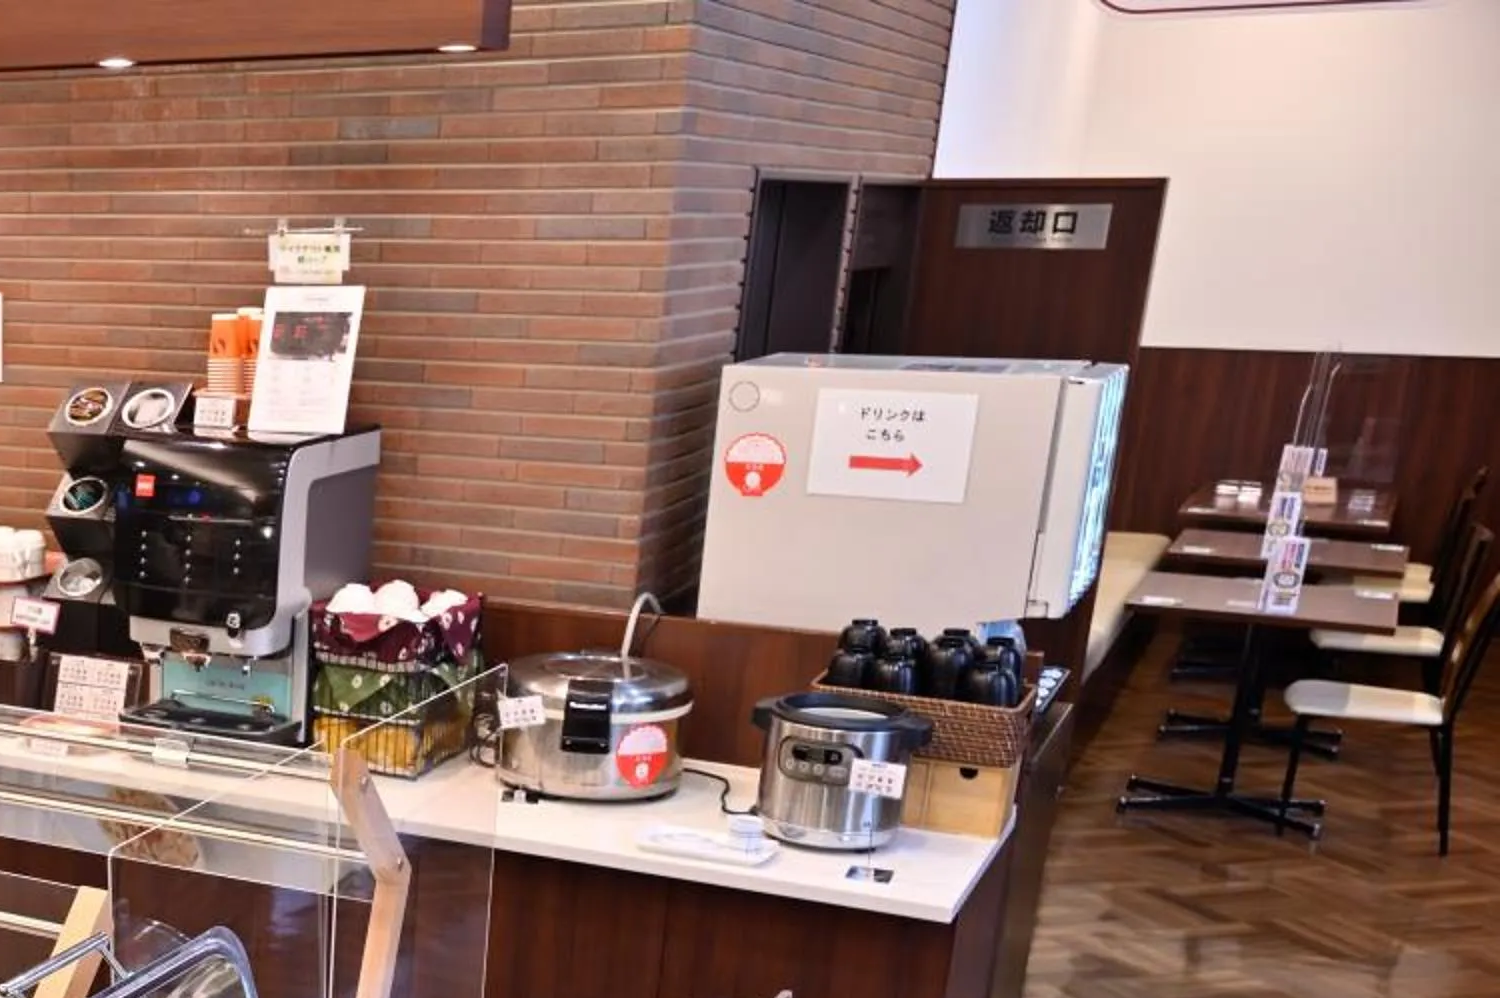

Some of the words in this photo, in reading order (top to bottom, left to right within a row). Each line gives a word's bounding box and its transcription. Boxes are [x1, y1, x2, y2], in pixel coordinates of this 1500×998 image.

[988, 209, 1078, 234] 返却口
[861, 407, 925, 422] ドリンクは
[866, 428, 905, 442] こちら
